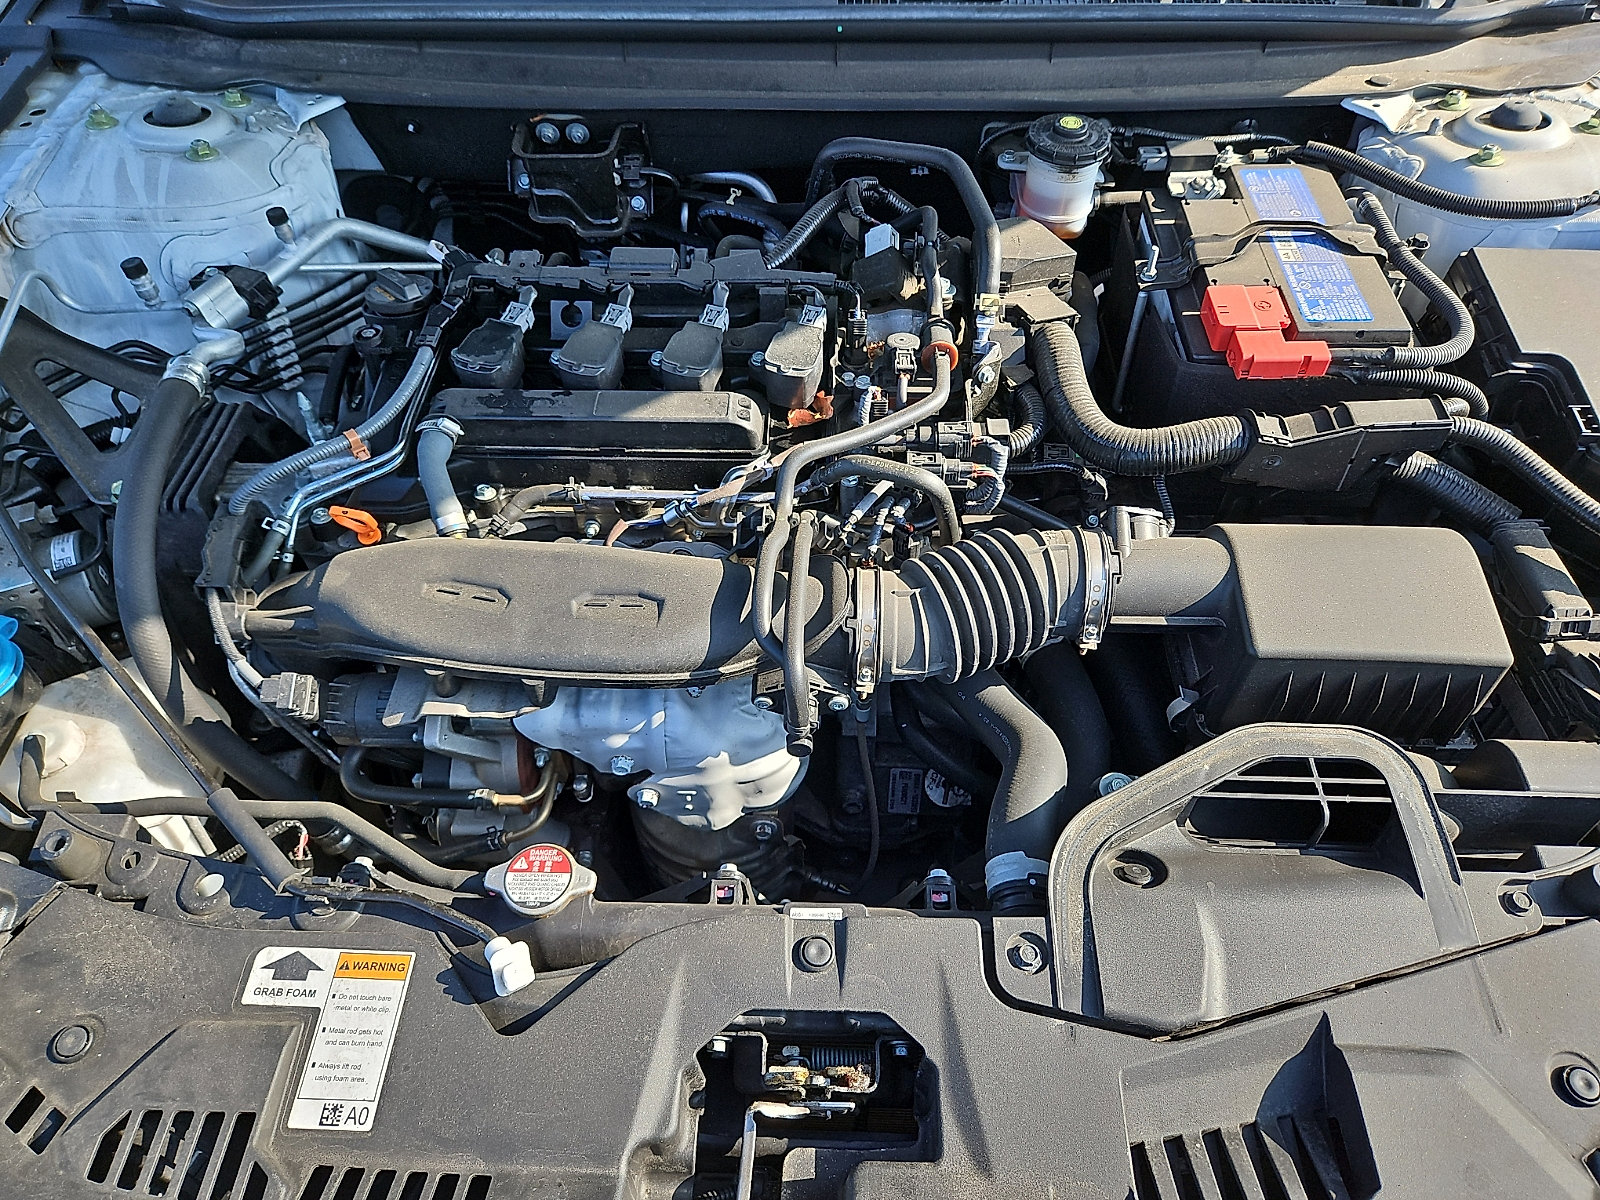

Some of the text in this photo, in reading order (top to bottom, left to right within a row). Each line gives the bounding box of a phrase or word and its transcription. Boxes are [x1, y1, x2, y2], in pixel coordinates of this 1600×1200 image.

[529, 854, 563, 862] WARNUNG
[352, 961, 406, 972] WARNING
[253, 987, 317, 998] GRAB FOAM
[317, 1062, 341, 1071] Always
[341, 1062, 350, 1070] lift
[314, 1075, 332, 1083] using
[344, 1106, 370, 1126] A0
